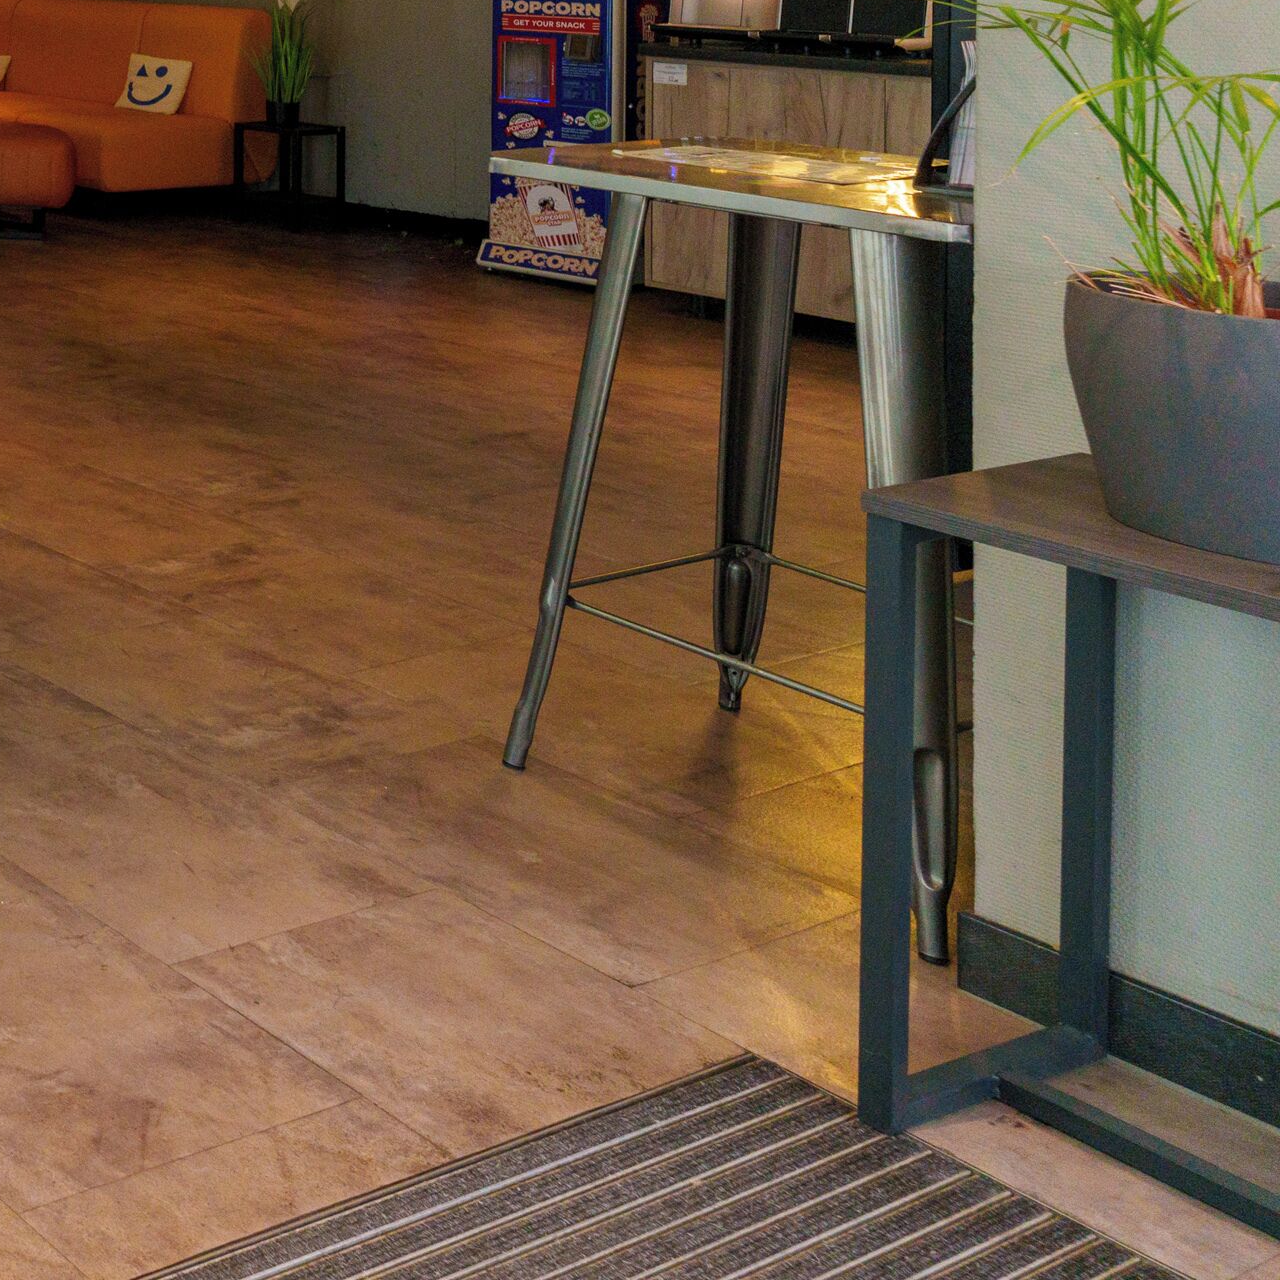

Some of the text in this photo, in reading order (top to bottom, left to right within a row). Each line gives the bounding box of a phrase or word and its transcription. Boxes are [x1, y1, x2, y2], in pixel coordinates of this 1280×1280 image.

[501, 0, 601, 17] POPCORN
[513, 19, 585, 29] GET YOUR SNACK
[506, 119, 542, 132] POPCORN
[489, 245, 599, 276] POPCORN
